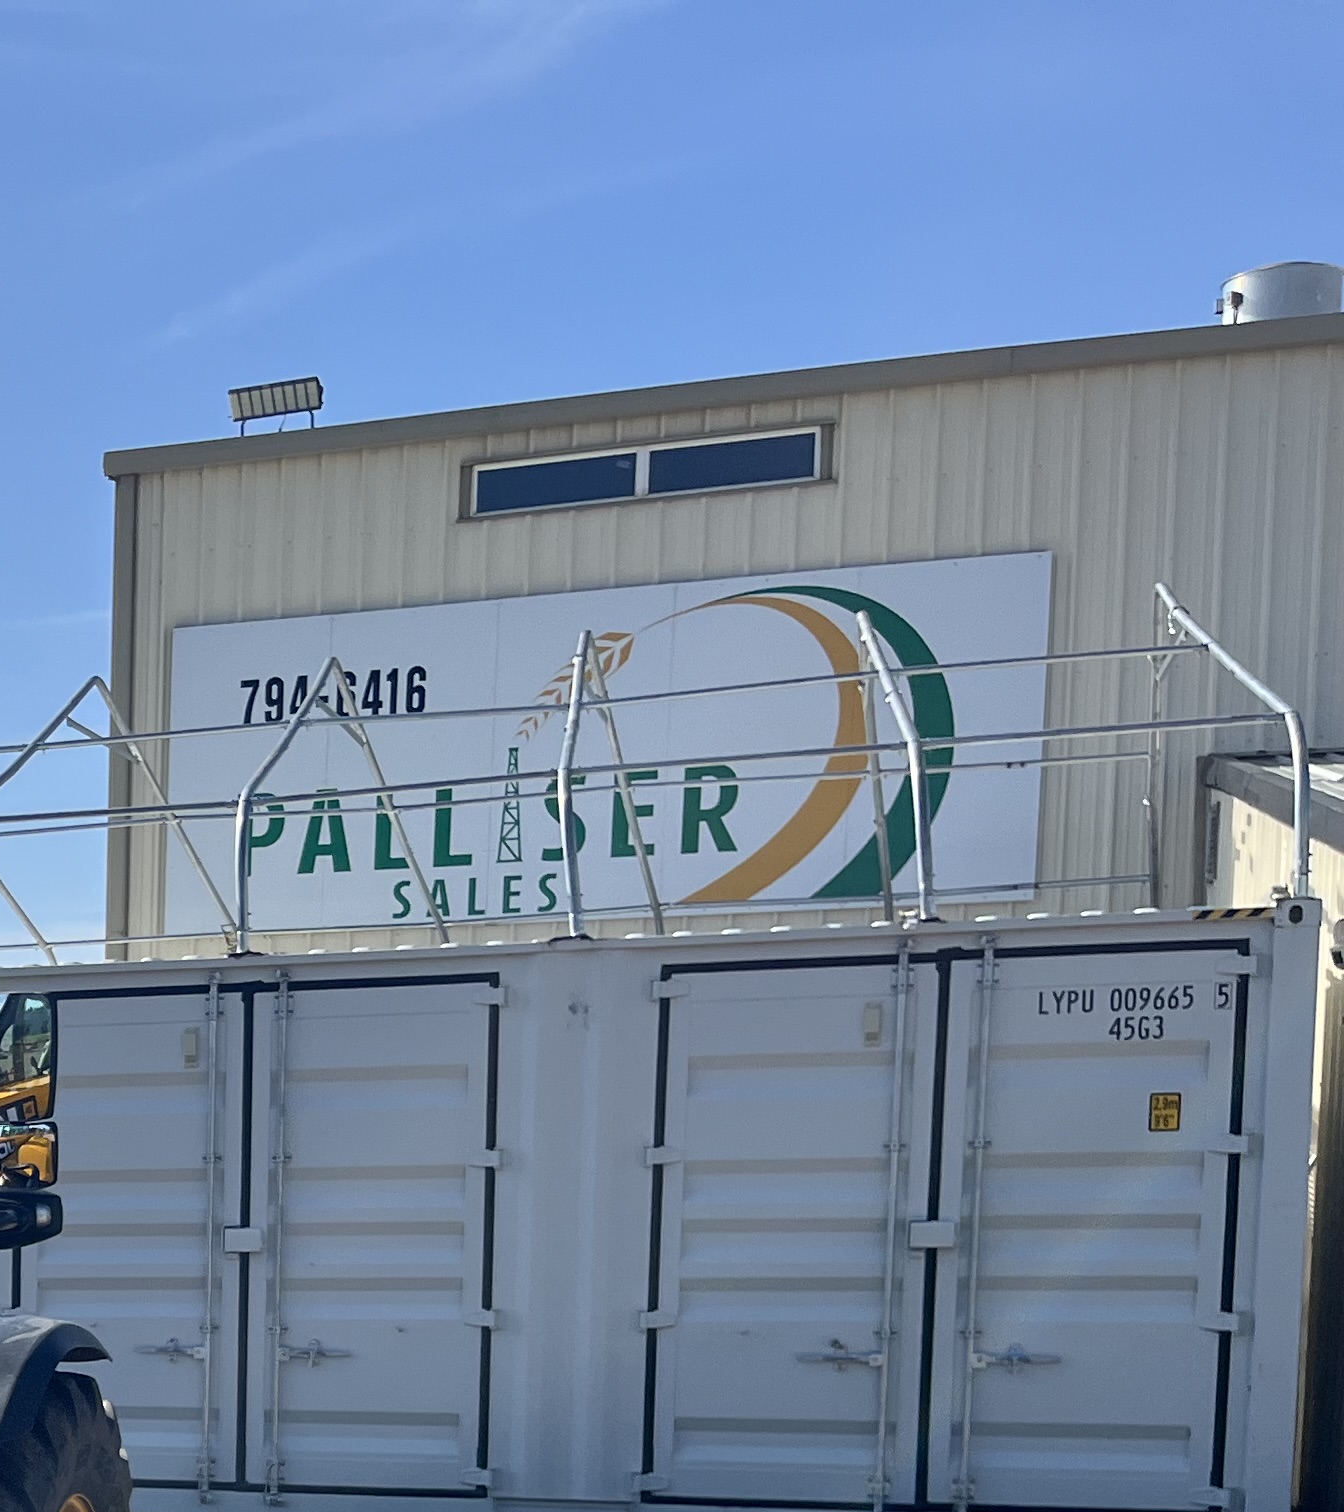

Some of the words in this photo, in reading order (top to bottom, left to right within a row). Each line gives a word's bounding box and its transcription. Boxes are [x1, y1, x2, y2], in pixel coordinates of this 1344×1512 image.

[240, 665, 427, 725] 794-6416
[392, 872, 558, 919] SALES
[1038, 988, 1095, 1016] LYPU
[1109, 984, 1195, 1013] 009665
[1216, 982, 1230, 1010] 5
[1108, 1015, 1165, 1042] 45G3
